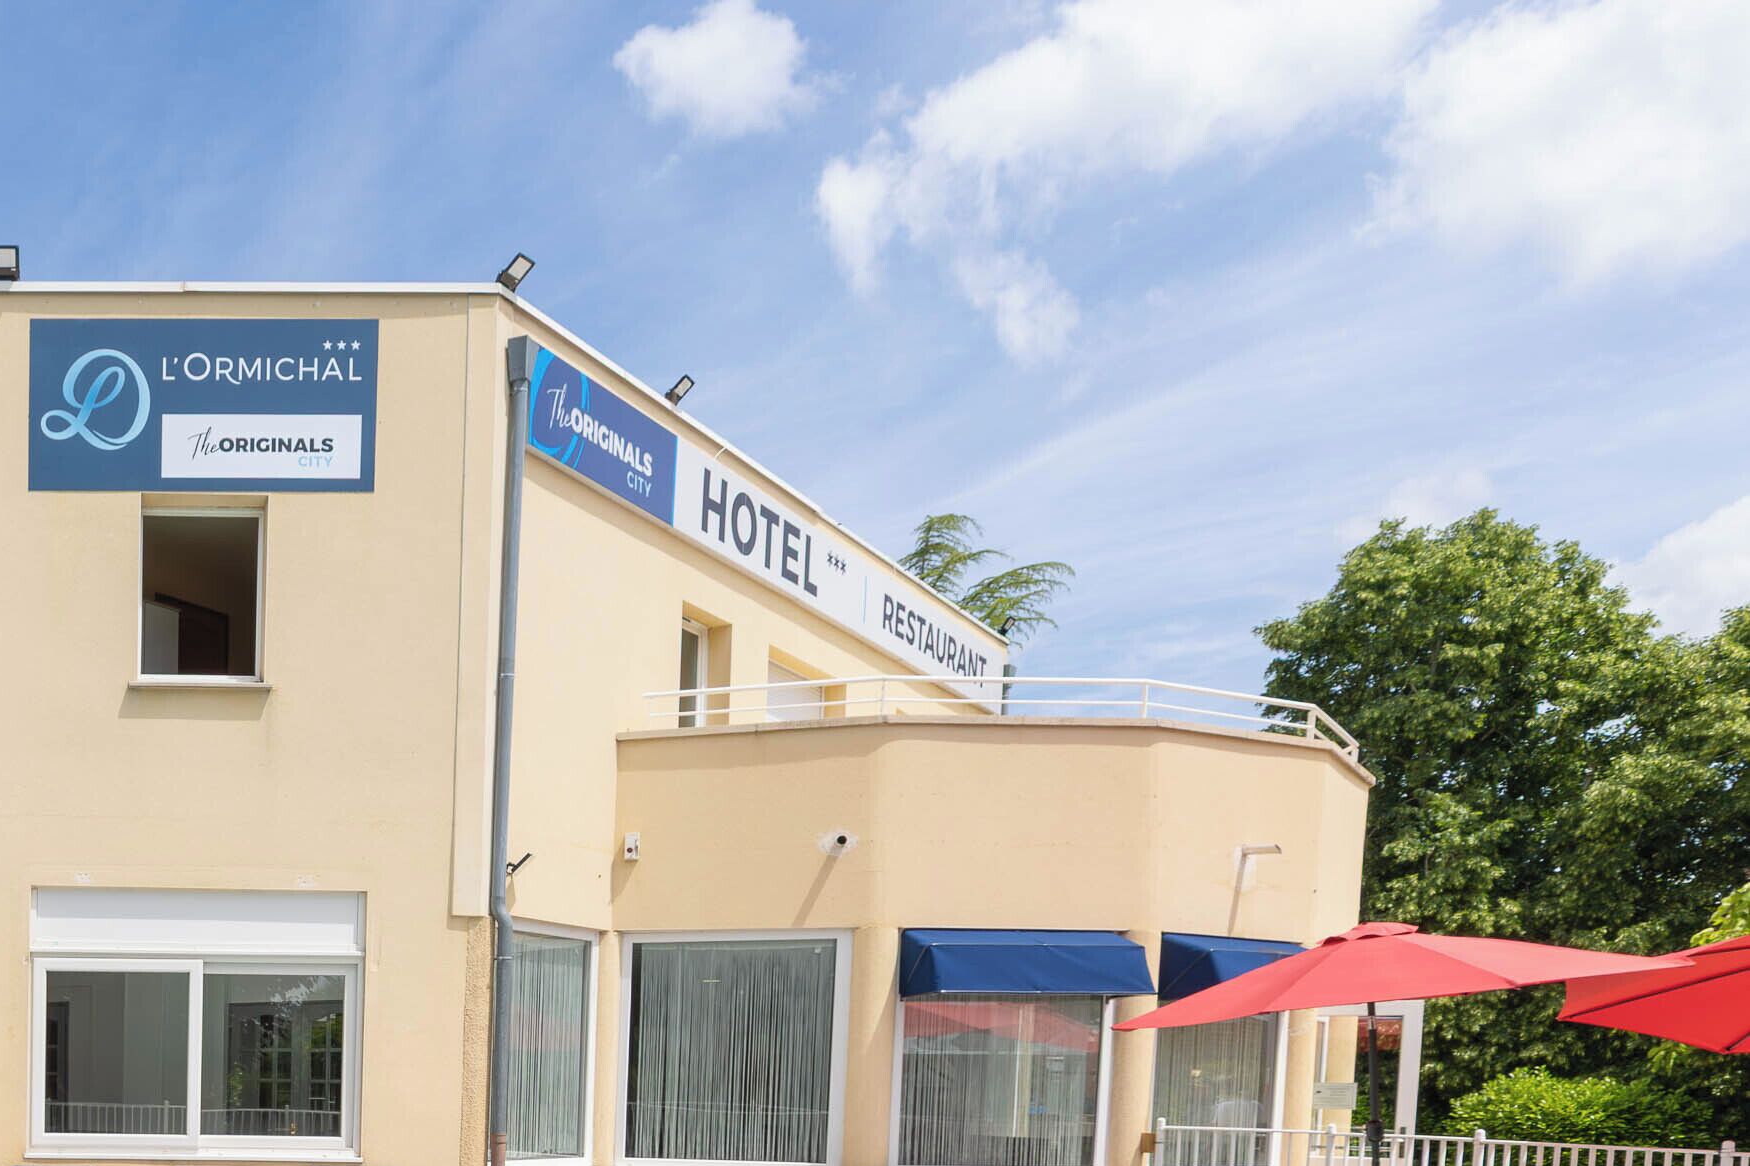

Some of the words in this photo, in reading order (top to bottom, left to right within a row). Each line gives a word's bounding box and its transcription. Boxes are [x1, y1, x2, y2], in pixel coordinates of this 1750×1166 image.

[298, 455, 333, 467] CITY
[626, 471, 652, 498] CITY
[701, 467, 817, 597] HOTEL
[882, 593, 987, 688] RESTAURANT
